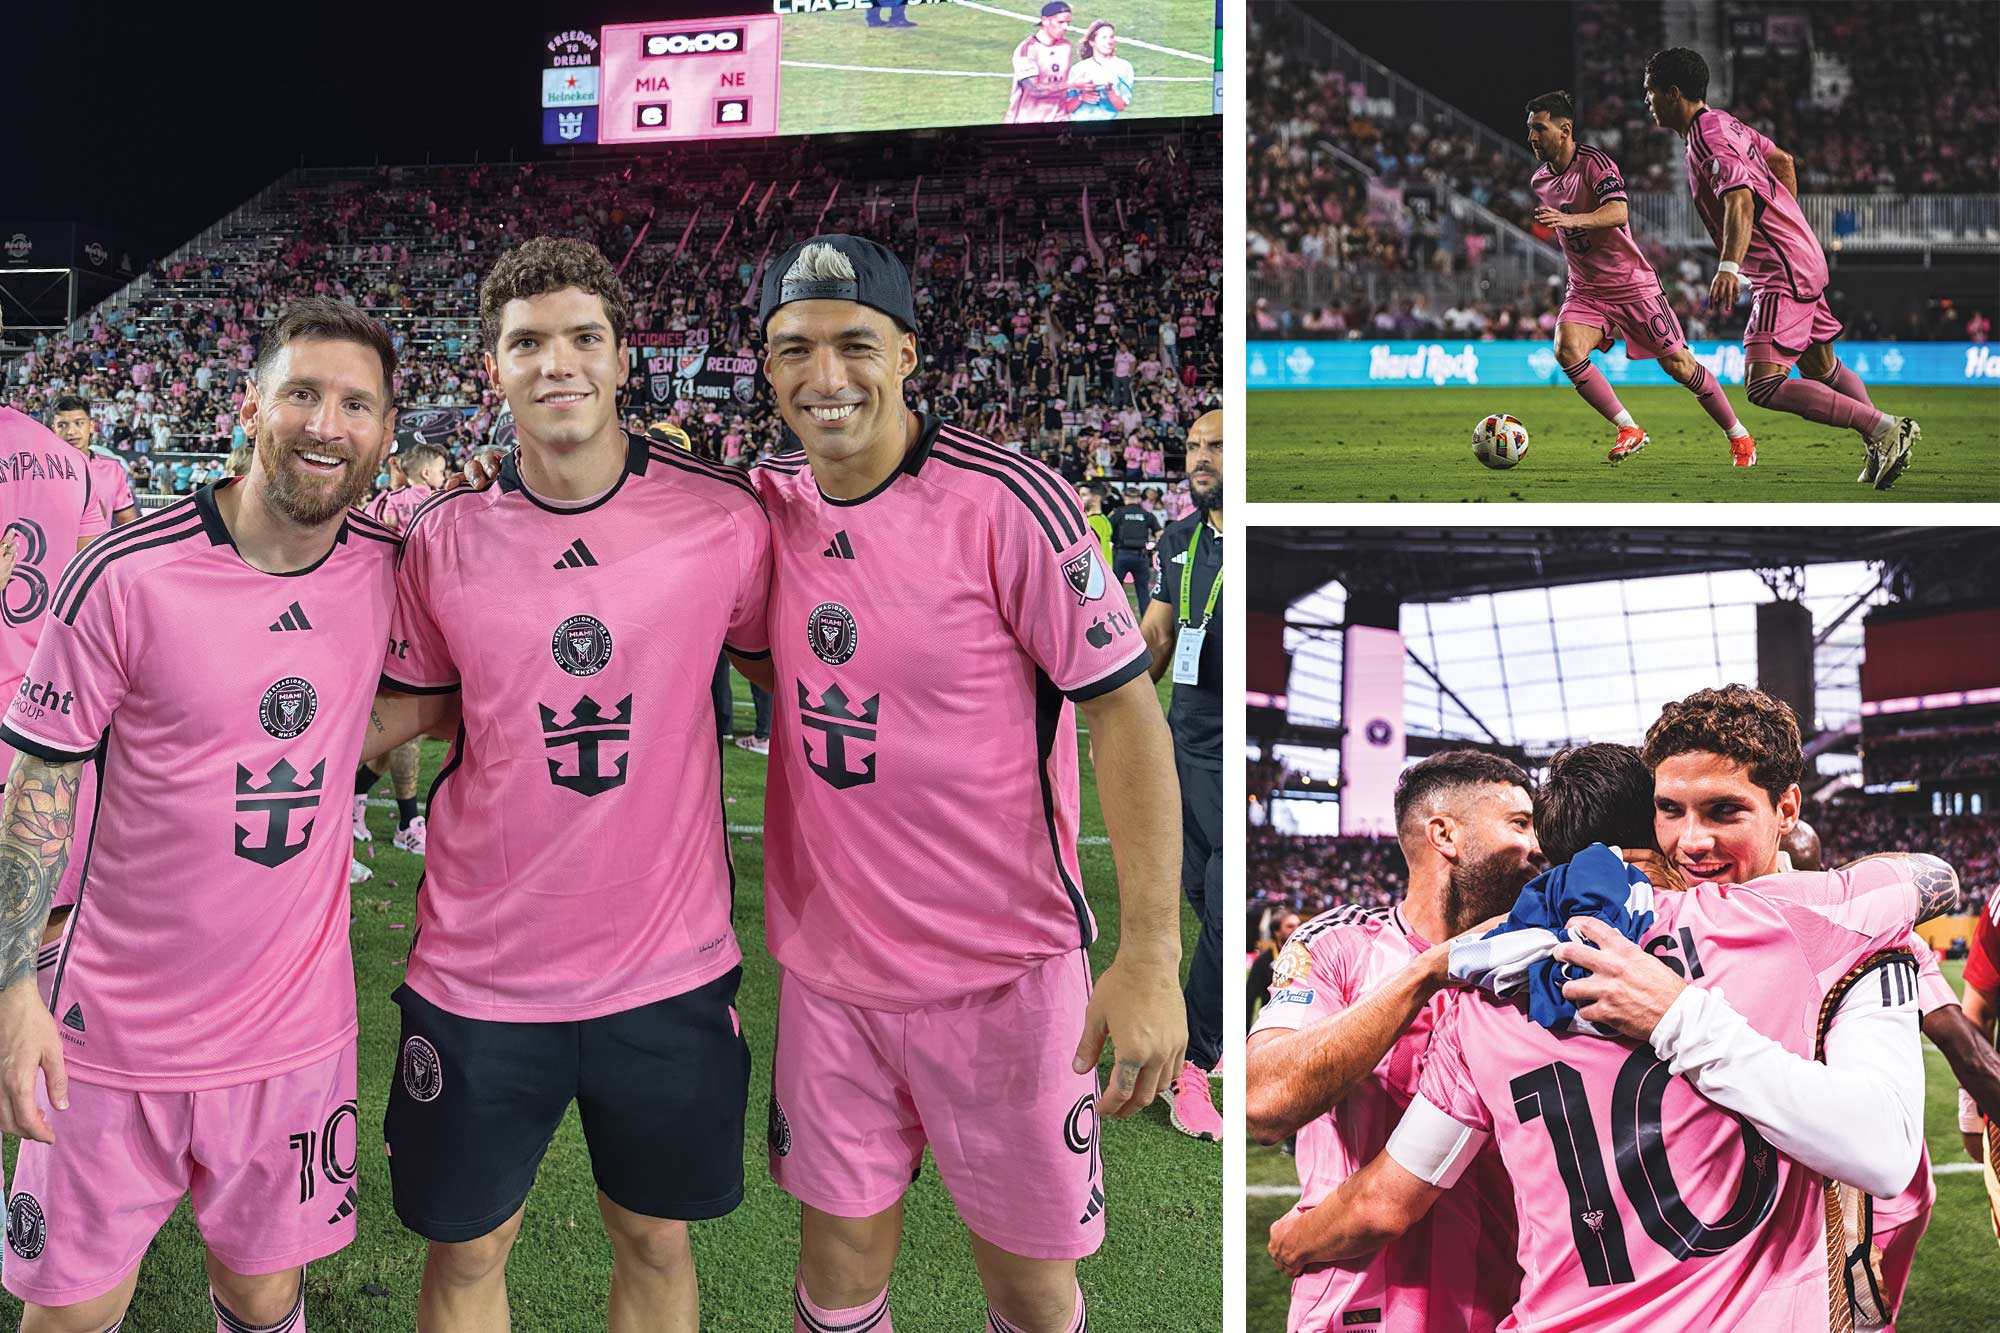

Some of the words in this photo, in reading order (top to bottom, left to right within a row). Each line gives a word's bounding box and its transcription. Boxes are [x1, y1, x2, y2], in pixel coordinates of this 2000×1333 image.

[547, 31, 598, 51] FREEDOM
[566, 43, 579, 53] TO
[648, 32, 738, 55] 90:00
[553, 54, 592, 66] DREAM
[636, 77, 670, 92] MIA
[721, 72, 745, 87] NE
[548, 91, 595, 102] Heineken
[641, 107, 663, 125] 6
[721, 103, 743, 122] 2
[1595, 179, 1621, 195] CAP
[1640, 313, 1670, 342] 10
[648, 357, 673, 374] NEW
[706, 357, 758, 374] RECORD
[1369, 344, 1426, 380] Hard
[1426, 344, 1479, 385] Rock
[672, 379, 695, 399] 74
[697, 387, 731, 400] POINTS
[0, 517, 49, 628] 8
[1066, 557, 1089, 576] MLS
[1107, 608, 1133, 636] tv
[20, 676, 74, 715] acht
[1063, 1093, 1098, 1183] 9
[289, 1099, 357, 1205] 10
[1509, 1042, 1779, 1287] 10
